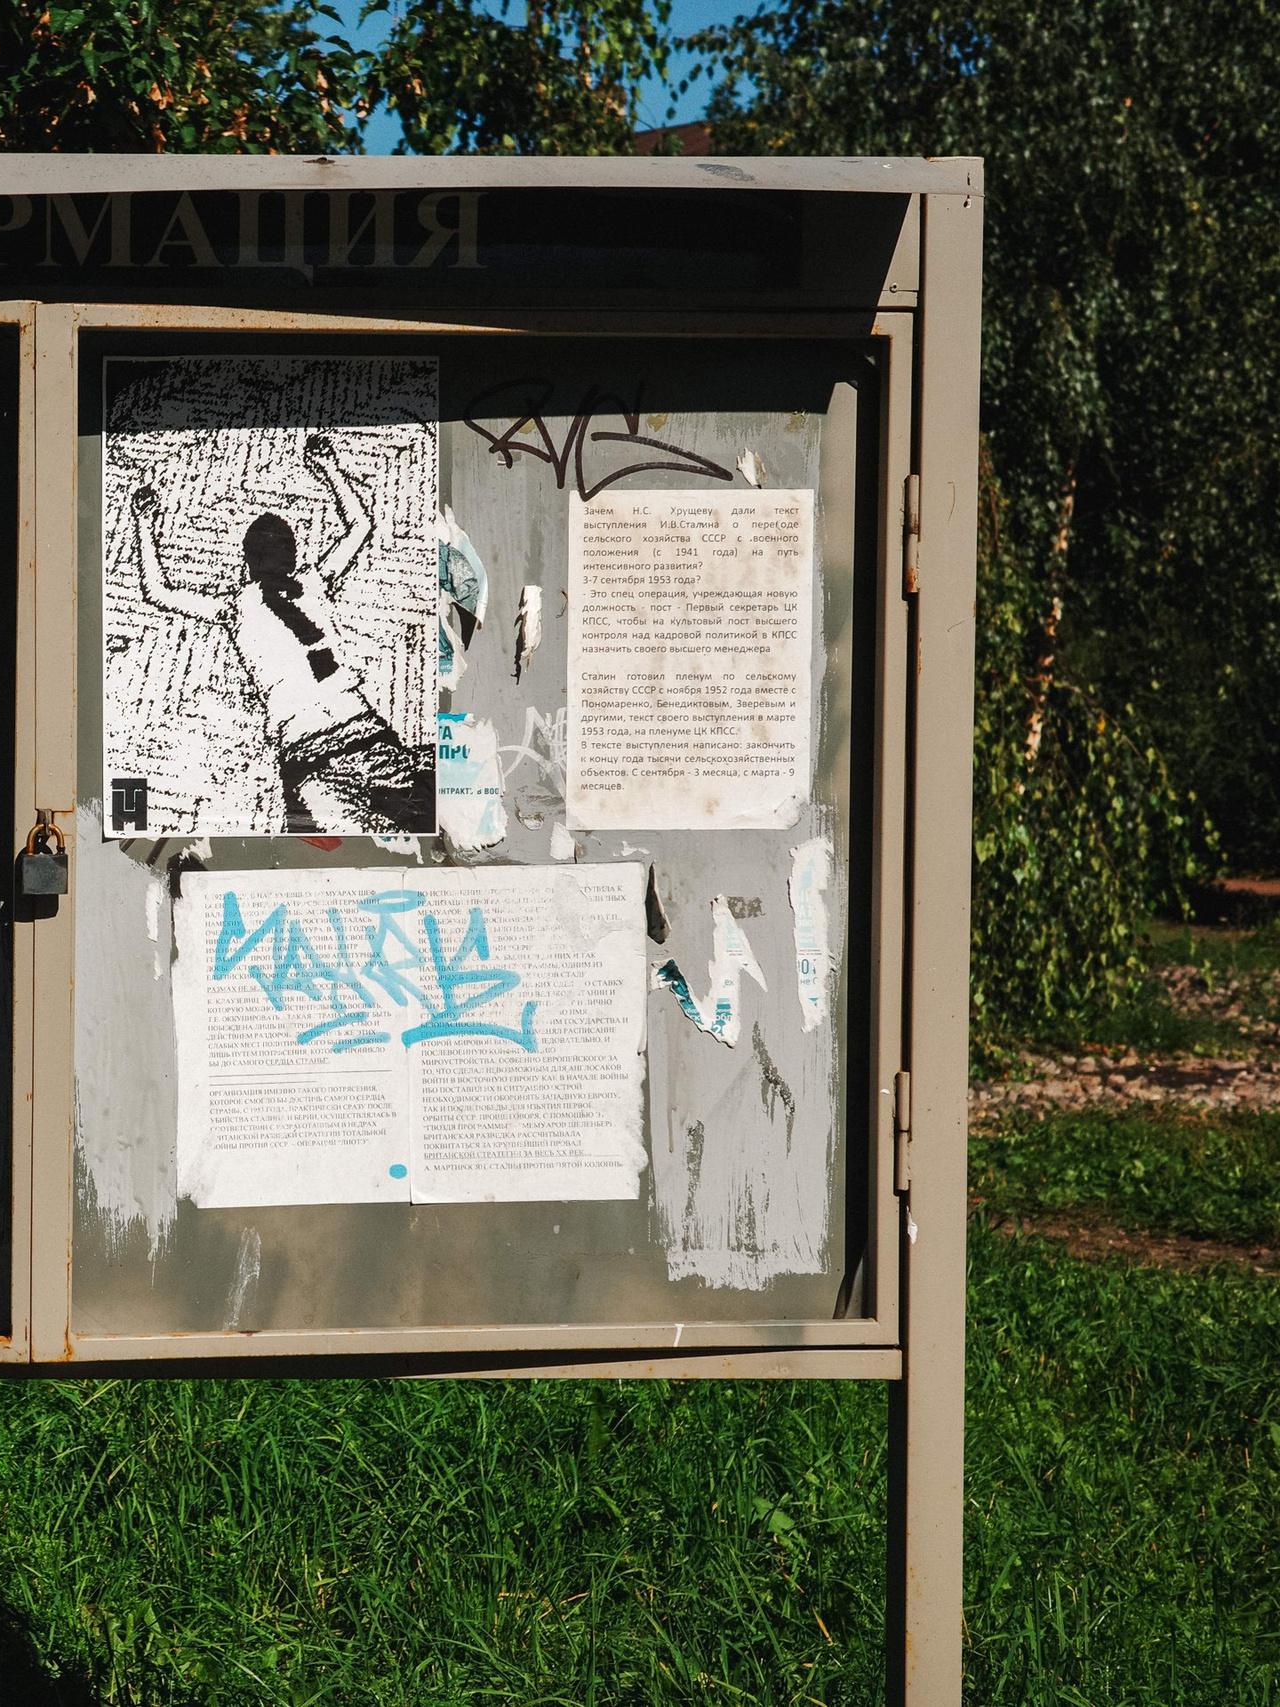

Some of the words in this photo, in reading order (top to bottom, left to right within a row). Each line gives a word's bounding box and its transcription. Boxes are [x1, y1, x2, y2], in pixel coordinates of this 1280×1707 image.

[584, 507, 613, 515] Зачем
[671, 507, 713, 516] Хрущеву
[731, 508, 755, 516] дали
[583, 522, 646, 530] выступления
[643, 534, 690, 543] хозяйства
[702, 534, 726, 542] СССР
[676, 548, 698, 556] 1941
[713, 547, 737, 557] года)
[778, 550, 798, 558] путь
[653, 562, 703, 571] развития?
[583, 576, 598, 584] 3-7
[601, 575, 645, 585] сентября
[648, 576, 671, 584] 1953
[674, 575, 701, 585] года?
[591, 590, 607, 598] Это
[611, 591, 634, 599] спец
[638, 591, 688, 599] операция,
[693, 591, 762, 599] учреждающая
[767, 591, 798, 599] новую
[686, 603, 723, 613] Первый
[729, 605, 778, 613] секретарь
[784, 603, 797, 612] ЦК
[655, 631, 701, 640] кадровой
[705, 630, 757, 639] политикой
[772, 631, 797, 639] КПСС
[670, 646, 711, 656] высшего
[714, 646, 770, 654] менеджера
[582, 700, 652, 709] Пономаренко,
[657, 700, 732, 709] Бенедиктовым,
[736, 700, 785, 709] Зверевым
[746, 739, 795, 749] закончить
